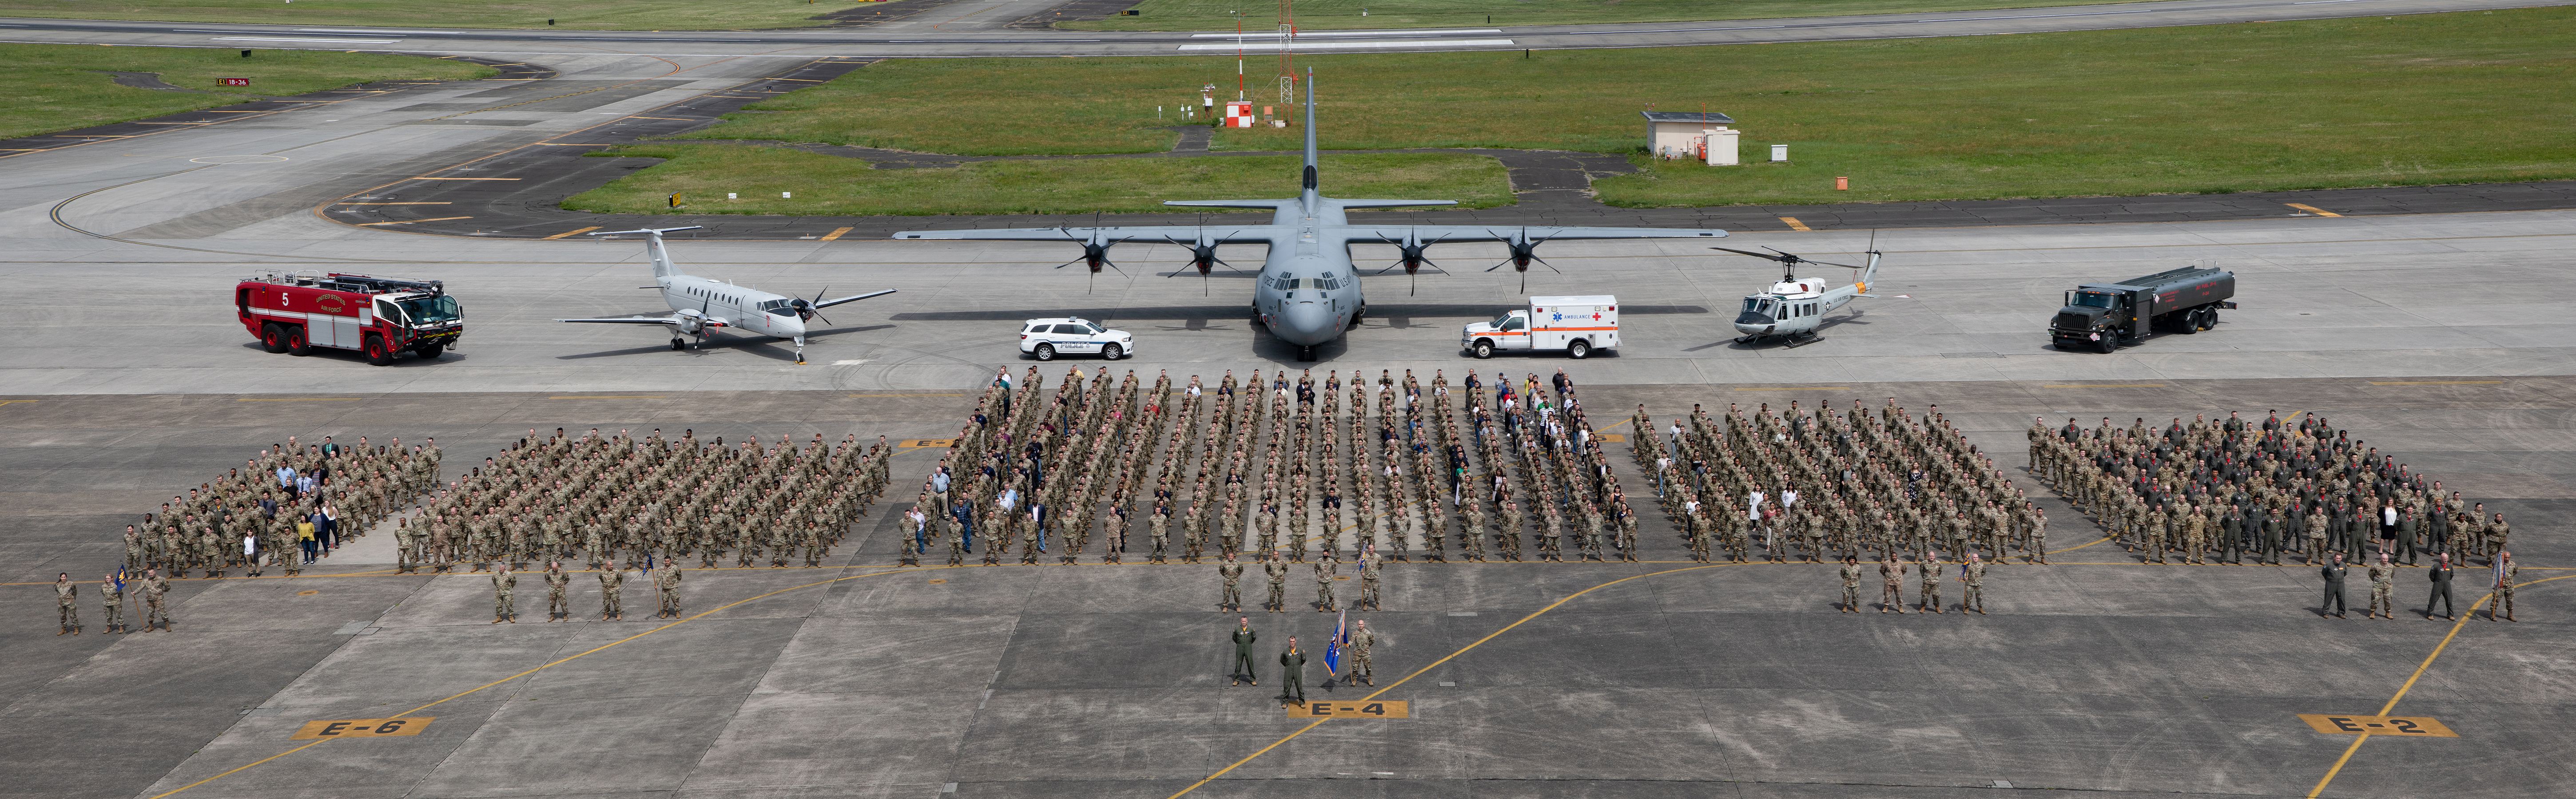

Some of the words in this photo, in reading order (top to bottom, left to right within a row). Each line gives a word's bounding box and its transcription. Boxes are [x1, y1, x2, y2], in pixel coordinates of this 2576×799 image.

[282, 292, 289, 307] 5
[316, 294, 330, 303] UNITED
[331, 294, 346, 306] STATES
[1312, 703, 1385, 716] E-4
[318, 720, 406, 736] E-6
[2327, 717, 2427, 733] E-2
